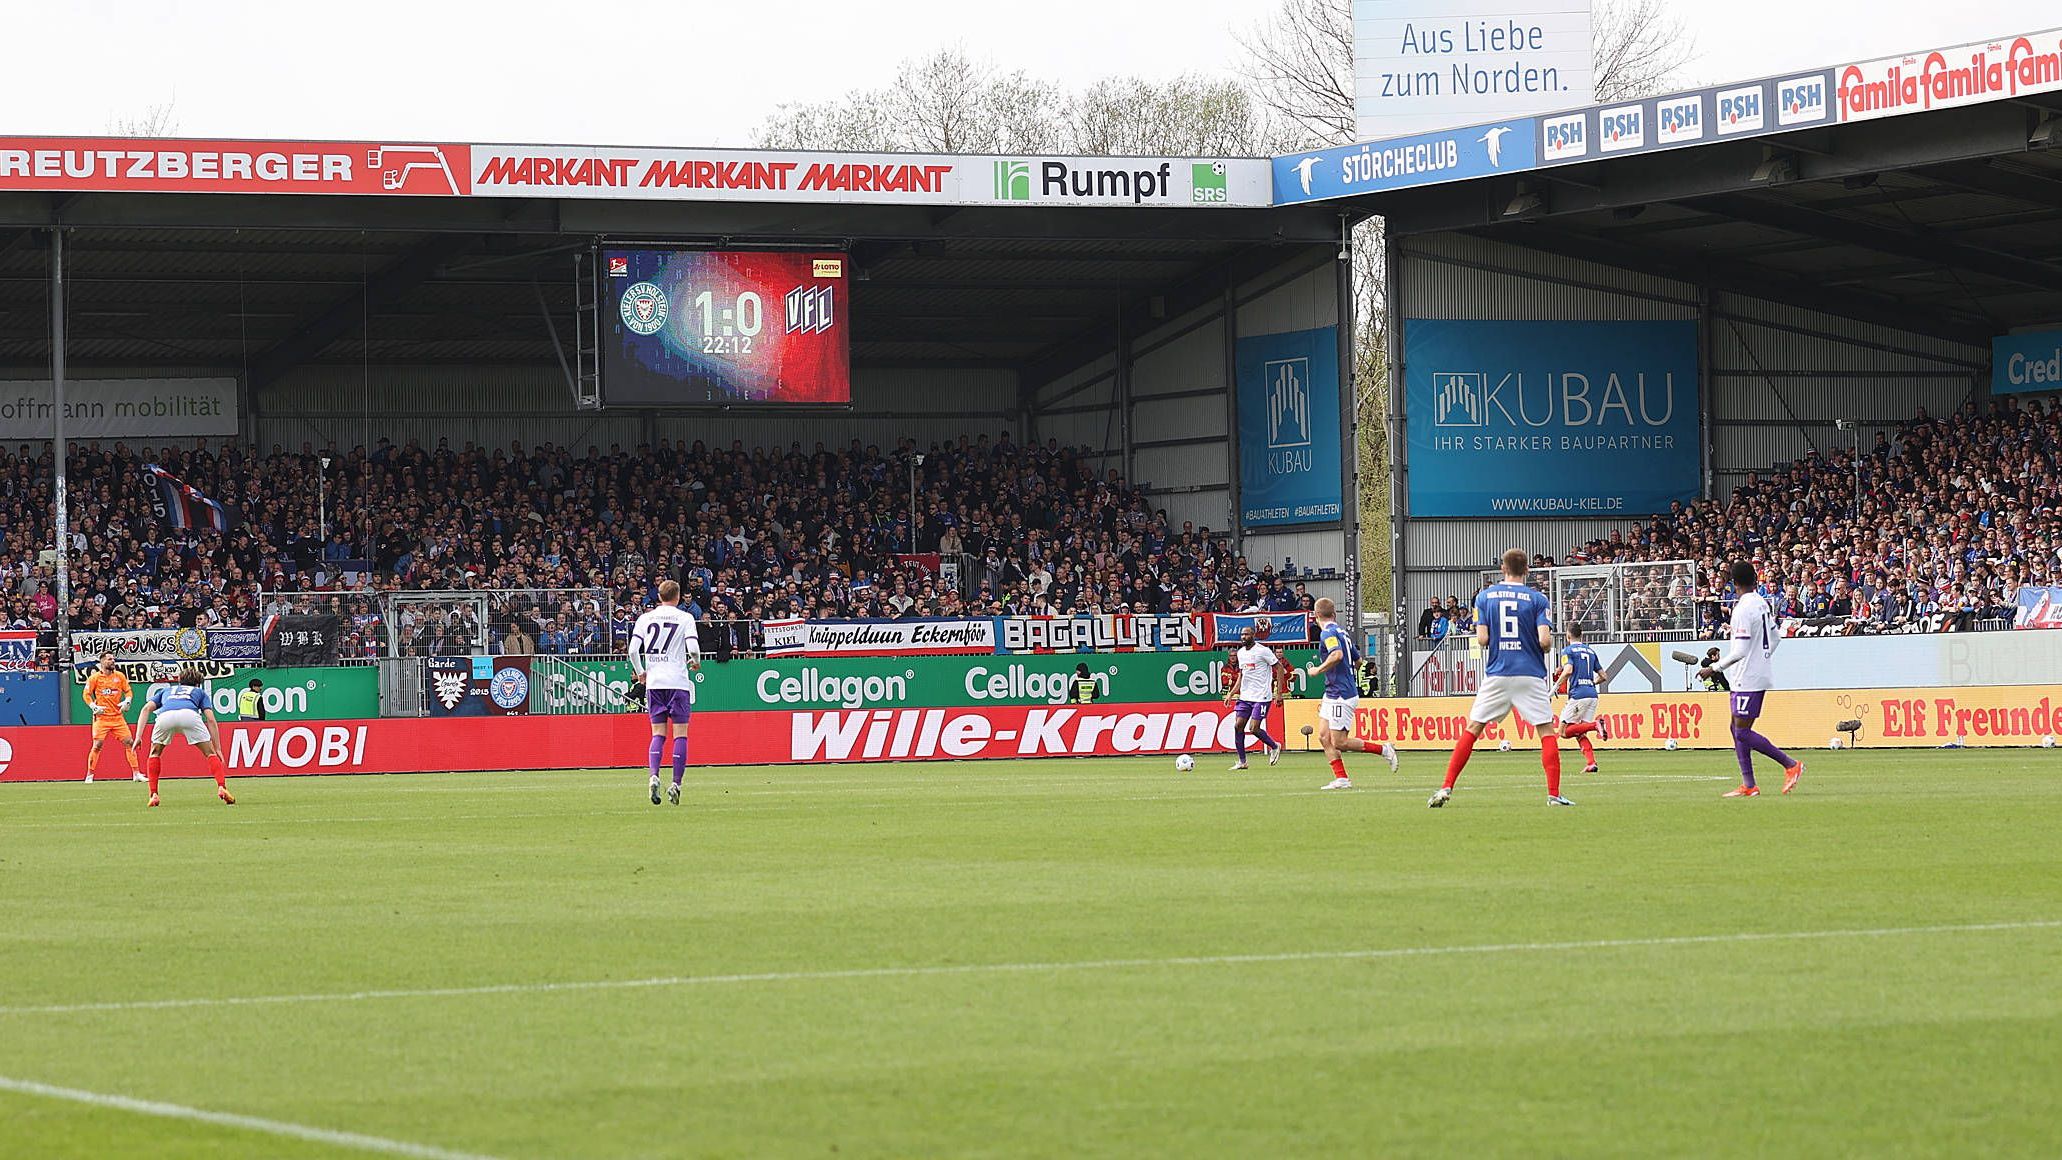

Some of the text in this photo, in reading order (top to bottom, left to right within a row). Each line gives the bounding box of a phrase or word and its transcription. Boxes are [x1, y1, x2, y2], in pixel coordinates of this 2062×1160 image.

[1401, 20, 1543, 54] Aus Liebe
[1381, 61, 1568, 97] zum Norden.
[1920, 52, 2003, 109] famila
[1782, 84, 1821, 111] RSH
[1837, 65, 1917, 121] famila
[1661, 104, 1698, 130] RSH
[1720, 94, 1759, 120] RSH
[1547, 122, 1582, 146] RSH
[1604, 112, 1640, 138] RSH
[0, 150, 353, 181] REUTZBERGER
[477, 157, 953, 193] MARKANT MARKANT MARKANT
[1342, 140, 1459, 184] STÖRCHECLUB
[1041, 161, 1170, 204] Rumpf
[1193, 187, 1227, 202] SRS
[695, 291, 762, 337] 1:0
[703, 336, 752, 354] 22:12
[115, 396, 221, 417] mobilität
[1484, 373, 1673, 426] KUBAU
[1435, 435, 1674, 450] IHR STARKER BAUPARTNER
[1268, 450, 1312, 474] KUBAU
[1245, 504, 1340, 520] #BAUATHLETEN #BAUATHLETEN
[1491, 498, 1623, 511] WWW.KUBAU-KIEL.DE
[1003, 616, 1204, 648] BAGALUTEN
[1500, 601, 1518, 638] 6
[128, 634, 176, 654] JUNGS
[646, 622, 680, 654] 27
[775, 636, 799, 646] KIEL
[808, 621, 986, 650] Knüppelduun Eckernföör
[428, 657, 456, 668] Garde
[1581, 653, 1590, 677] 7
[1331, 705, 1342, 718] 10
[1736, 696, 1750, 710] 17
[1354, 707, 1388, 741] Elf
[1650, 703, 1703, 739] Elf?
[1881, 699, 1926, 737] Elf
[228, 725, 368, 769] MOBI
